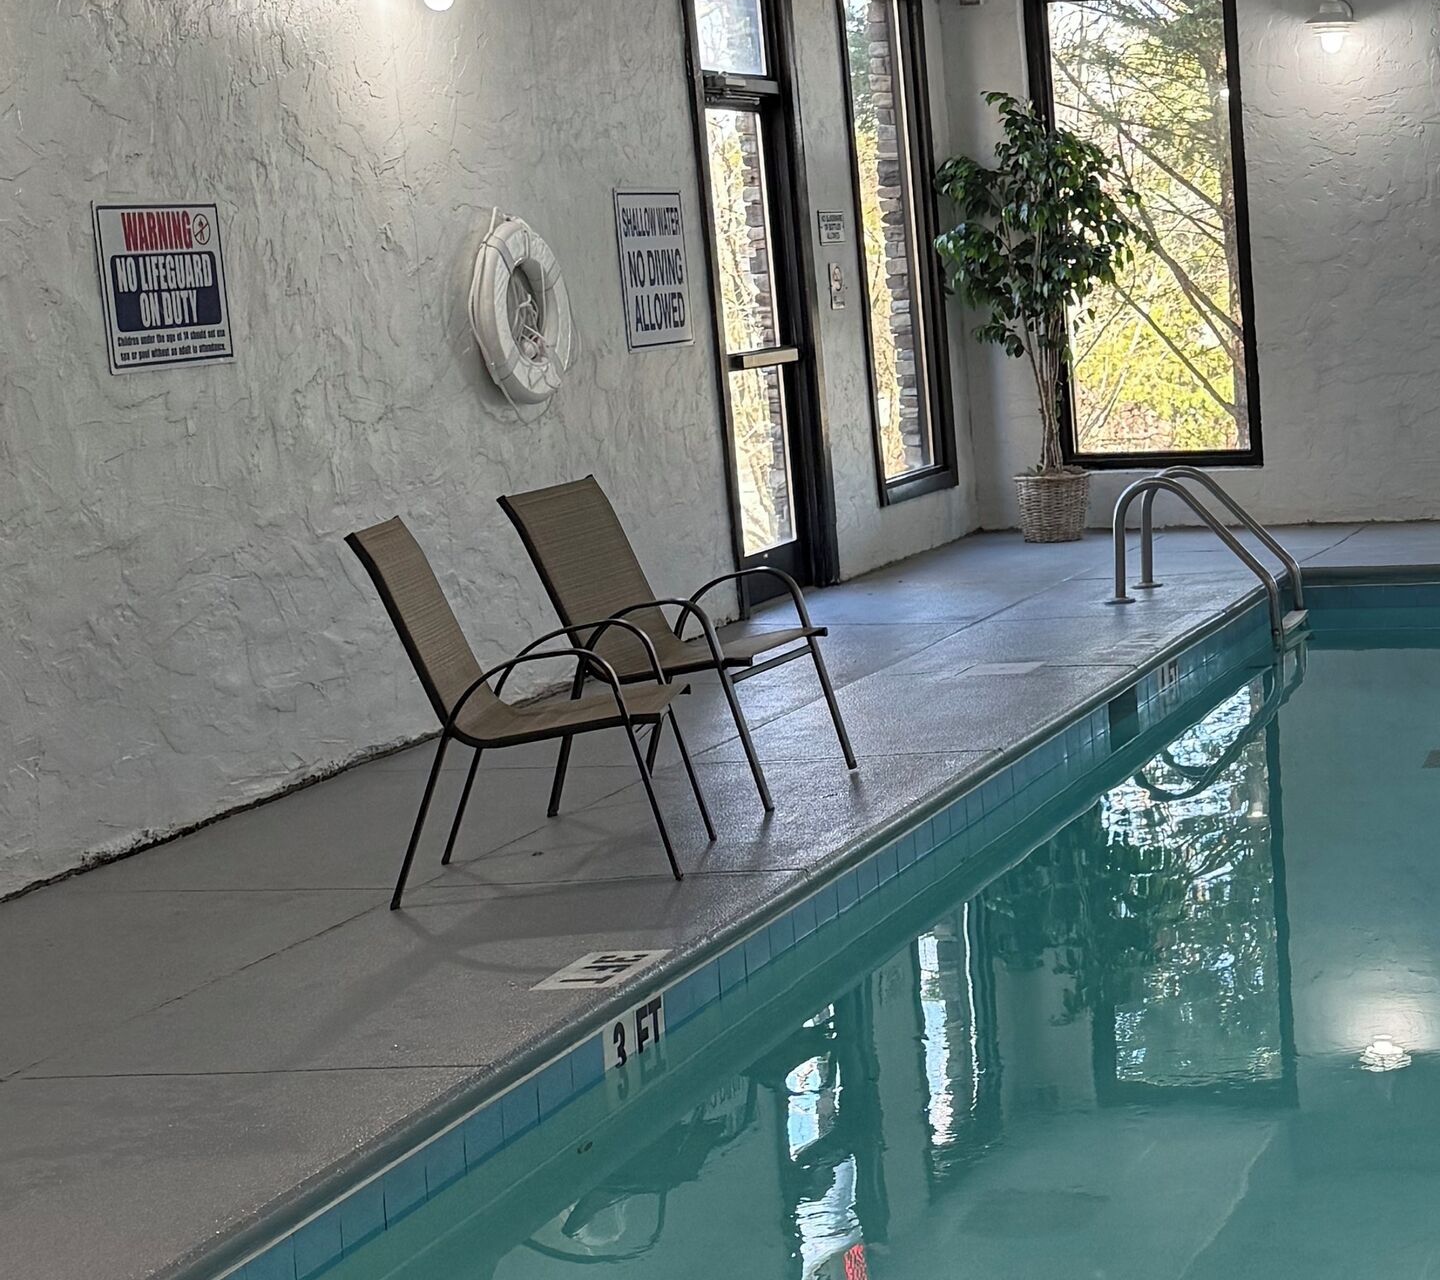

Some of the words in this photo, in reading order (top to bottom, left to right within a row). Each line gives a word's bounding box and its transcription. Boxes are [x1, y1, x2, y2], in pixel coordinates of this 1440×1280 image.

[121, 210, 193, 252] WARNING
[621, 207, 657, 237] SHALLOW
[657, 207, 681, 236] WATER
[115, 256, 138, 293] NO
[138, 253, 213, 291] LIFEGUARD
[627, 250, 646, 288] NO
[647, 248, 684, 287] DIVING
[139, 292, 161, 328] ON
[161, 289, 198, 326] DUTY
[635, 291, 686, 332] ALLOWED
[613, 1021, 627, 1068] 3
[635, 995, 662, 1055] FT
